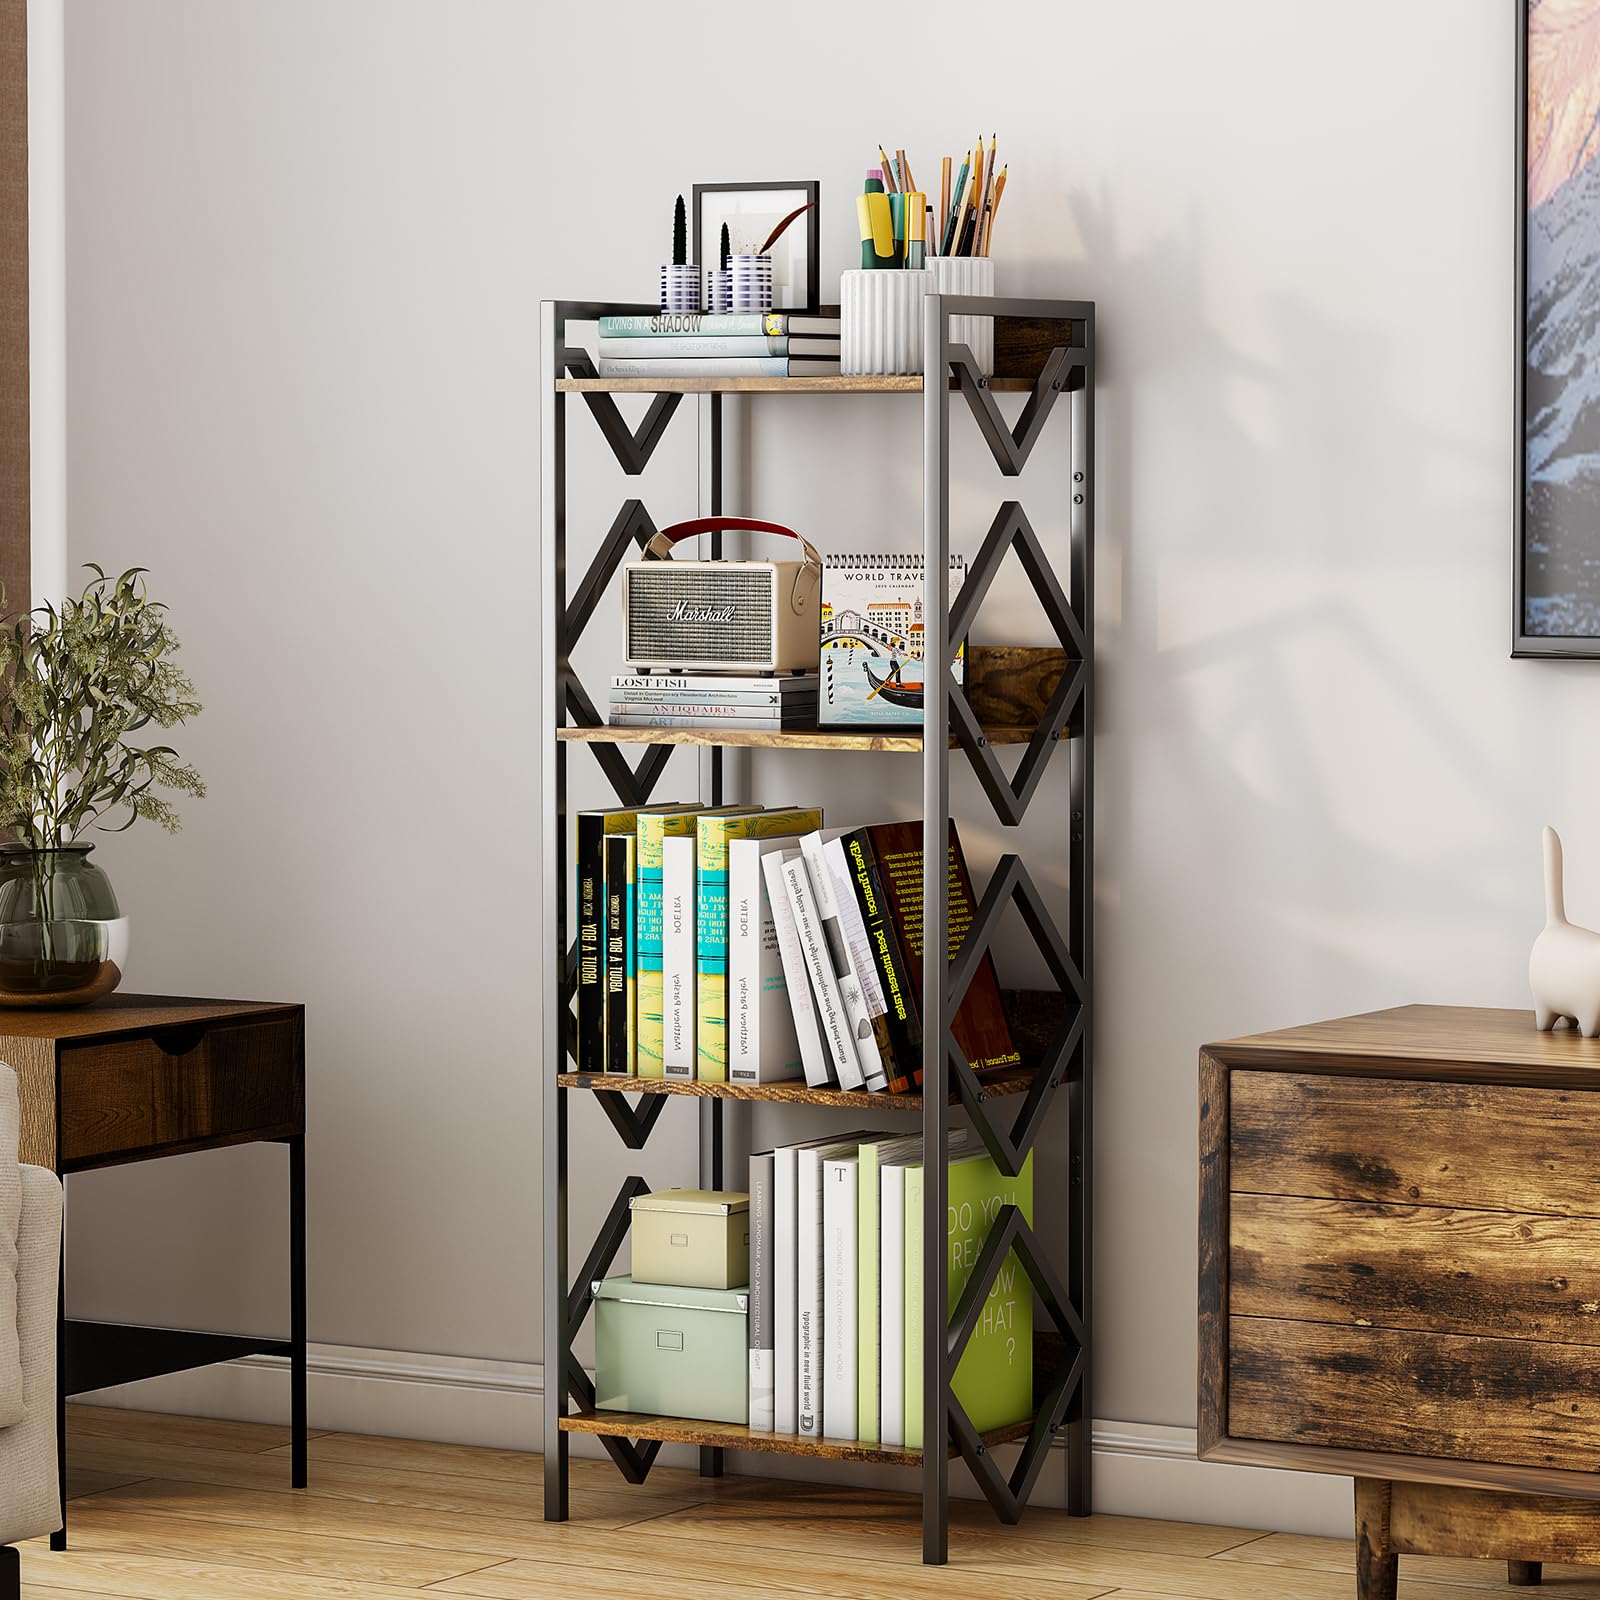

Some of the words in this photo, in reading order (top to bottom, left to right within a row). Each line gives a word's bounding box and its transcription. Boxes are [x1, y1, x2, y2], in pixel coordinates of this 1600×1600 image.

[608, 318, 633, 330] LIVING
[633, 318, 641, 330] IN
[643, 318, 650, 329] A
[651, 315, 702, 333] SHADOW
[844, 573, 885, 581] WORLD
[890, 573, 925, 581] TRAVE
[666, 600, 736, 621] Marshall
[616, 678, 653, 688] LOST
[655, 678, 687, 688] FISH
[652, 704, 737, 714] ANTIQUAIRES
[650, 717, 675, 726] ART
[834, 1168, 847, 1182] T
[802, 1311, 811, 1350] typographic
